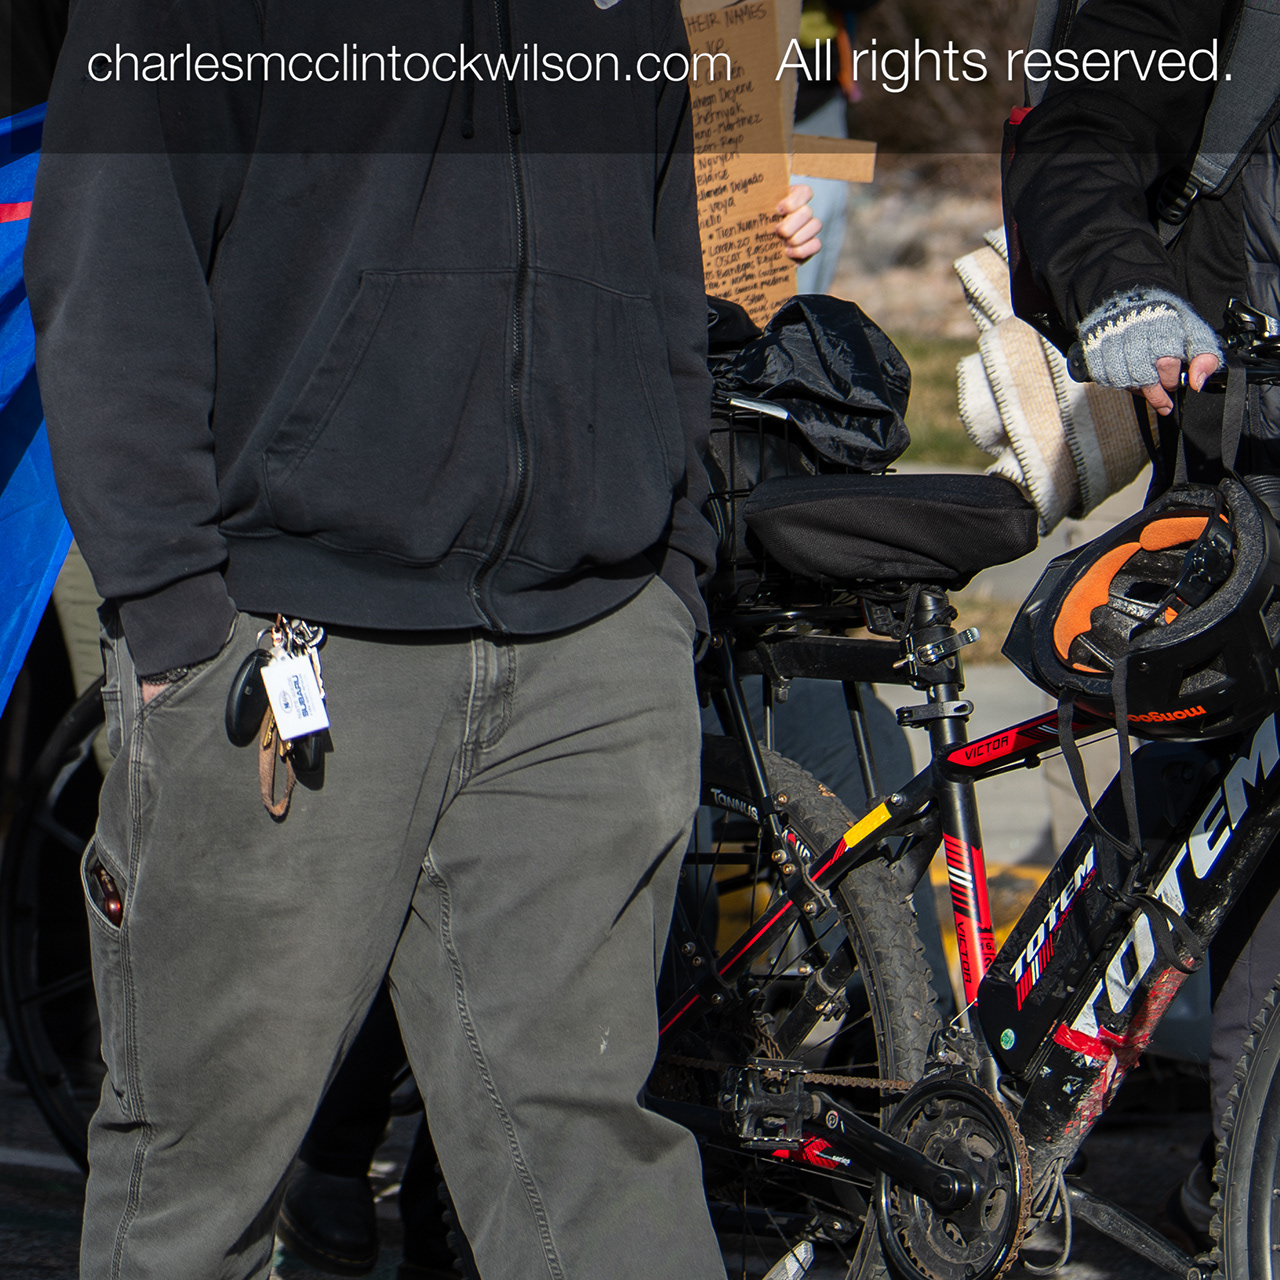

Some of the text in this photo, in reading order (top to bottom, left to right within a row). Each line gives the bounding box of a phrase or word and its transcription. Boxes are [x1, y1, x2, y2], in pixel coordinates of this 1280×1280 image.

[725, 3, 767, 28] NAMES
[292, 675, 310, 718] SUBARU
[965, 735, 1010, 761] VICTOR
[1010, 845, 1096, 980] TOTEM
[1071, 710, 1280, 1066] TOTEM
[957, 920, 972, 985] VICTOR
